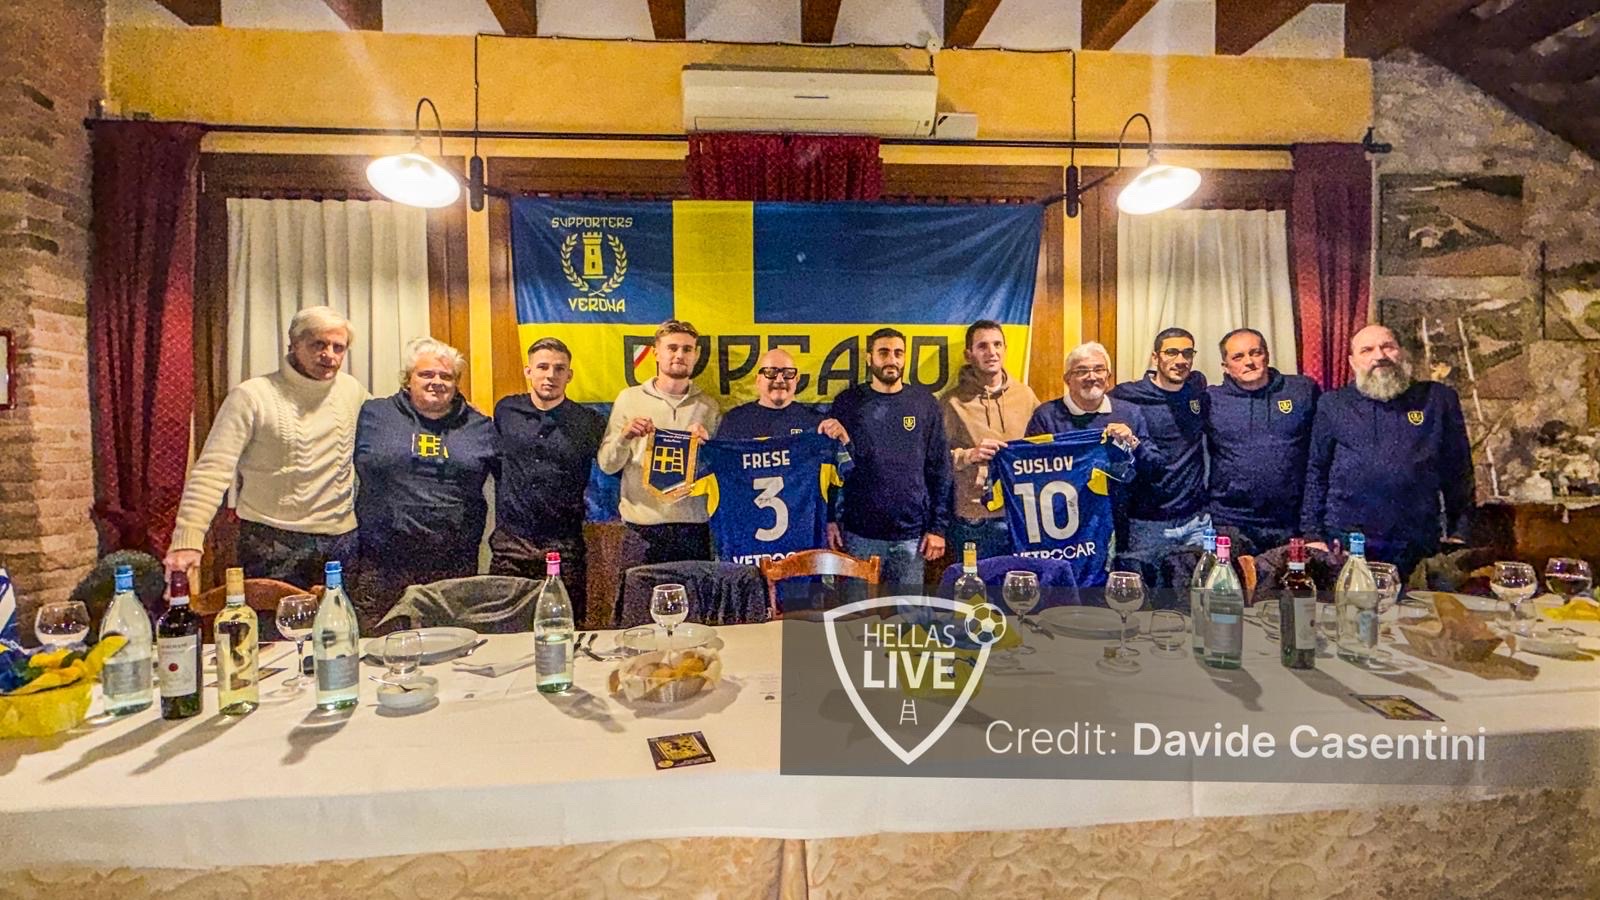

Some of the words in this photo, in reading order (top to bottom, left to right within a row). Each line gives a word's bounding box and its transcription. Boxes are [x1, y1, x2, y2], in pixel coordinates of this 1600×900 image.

[568, 297, 625, 312] VERONA
[742, 449, 790, 469] FRESE
[1012, 455, 1073, 476] SUSLOV
[753, 476, 789, 542] 3
[1013, 480, 1079, 544] 10
